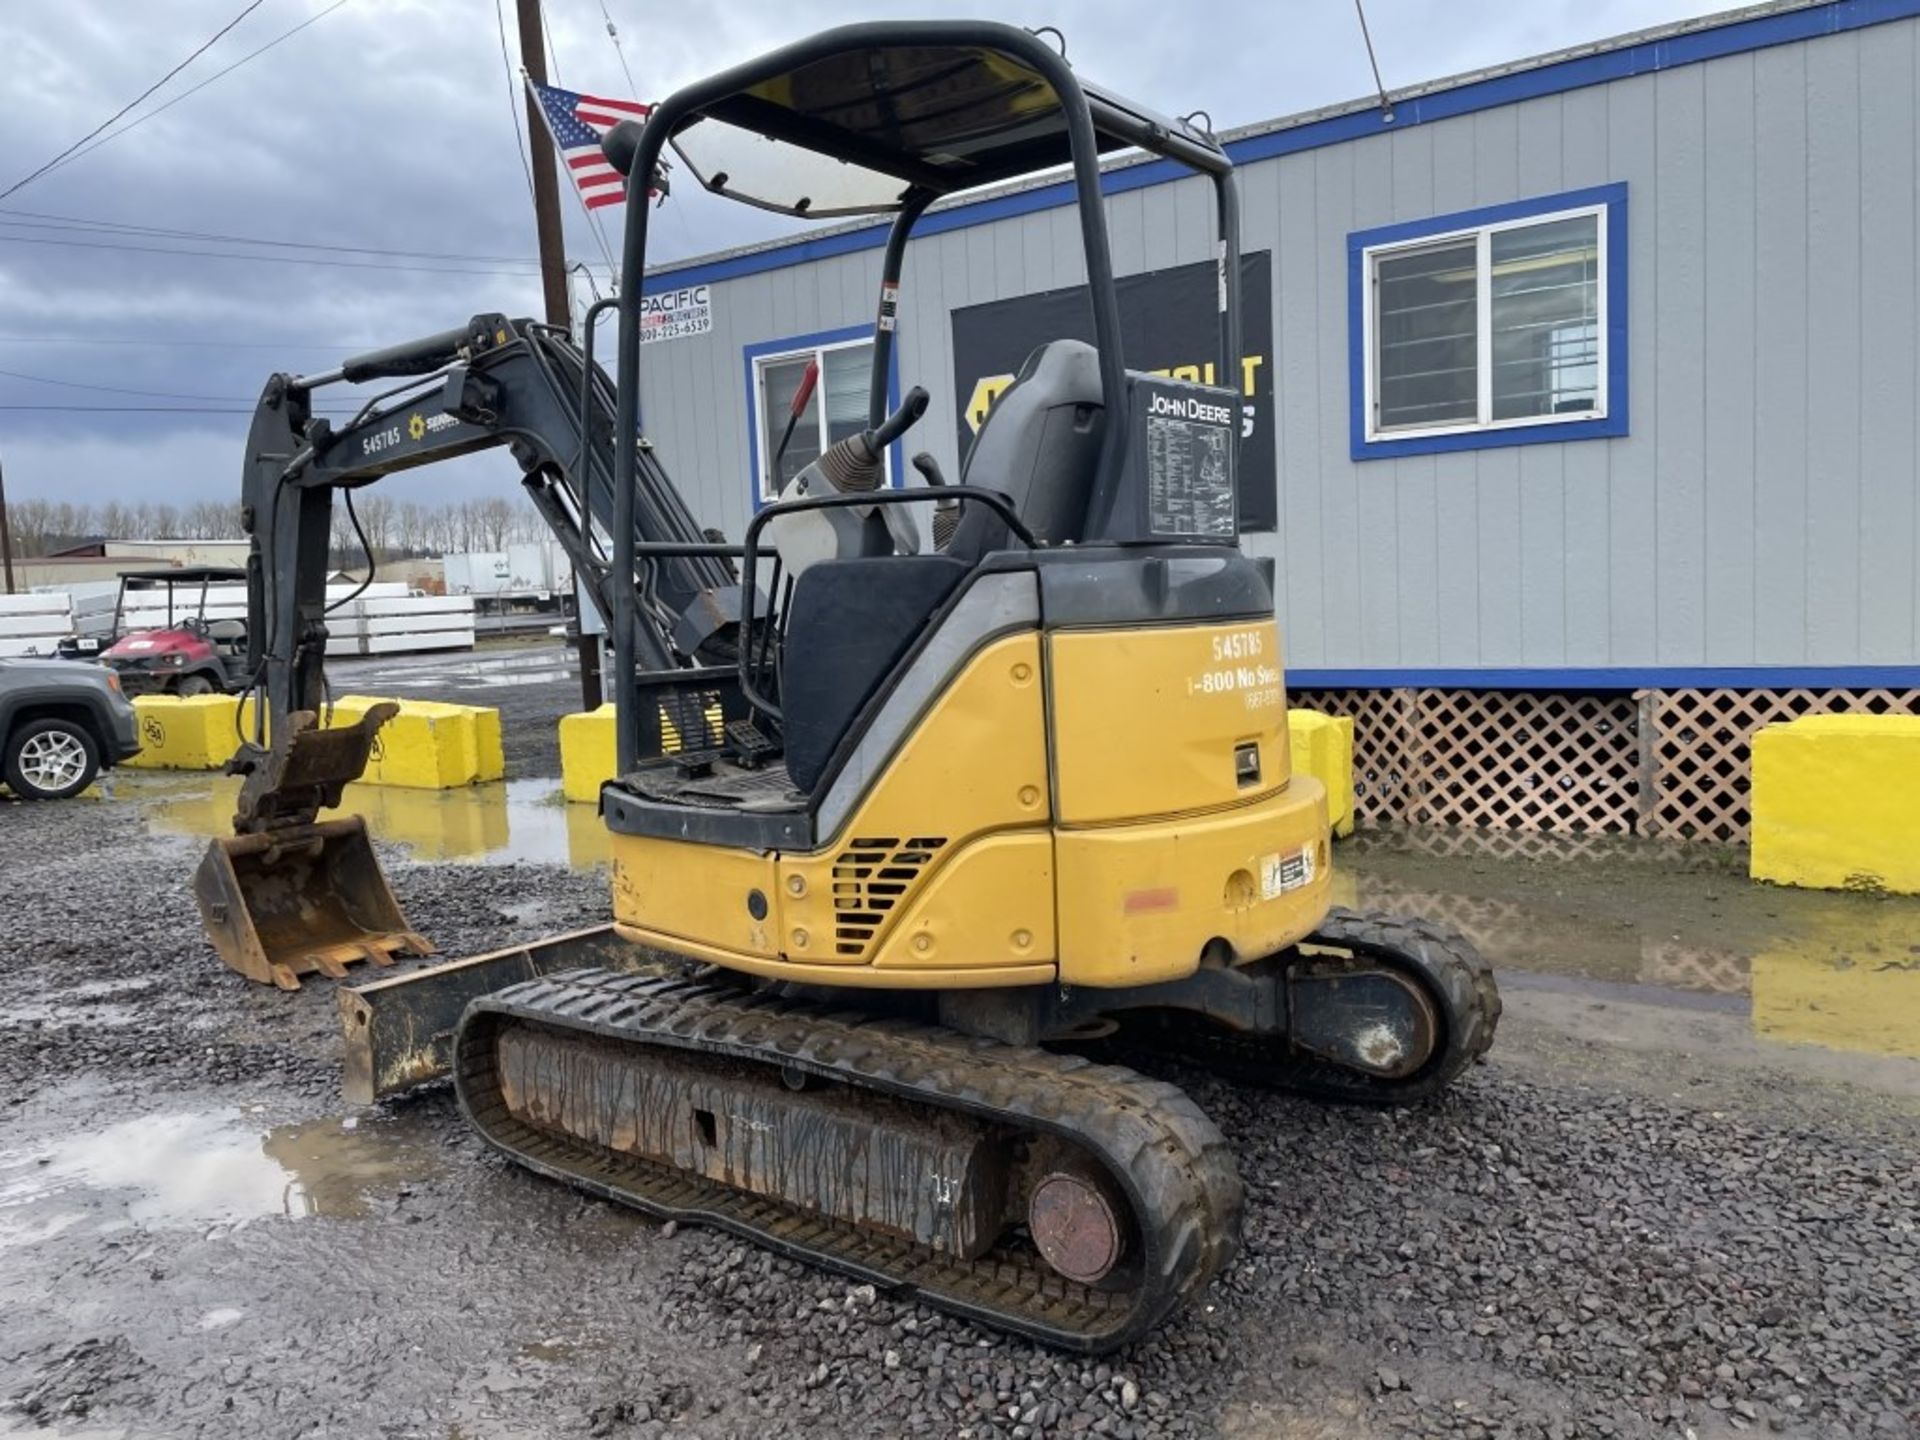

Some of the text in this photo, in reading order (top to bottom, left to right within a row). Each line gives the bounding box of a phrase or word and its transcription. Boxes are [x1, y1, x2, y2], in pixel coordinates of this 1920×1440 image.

[640, 287, 708, 314] PACIFIC
[1147, 392, 1187, 418] JOHN
[1188, 398, 1232, 425] DEERE
[1185, 670, 1235, 697] 1-800
[1236, 666, 1256, 689] No
